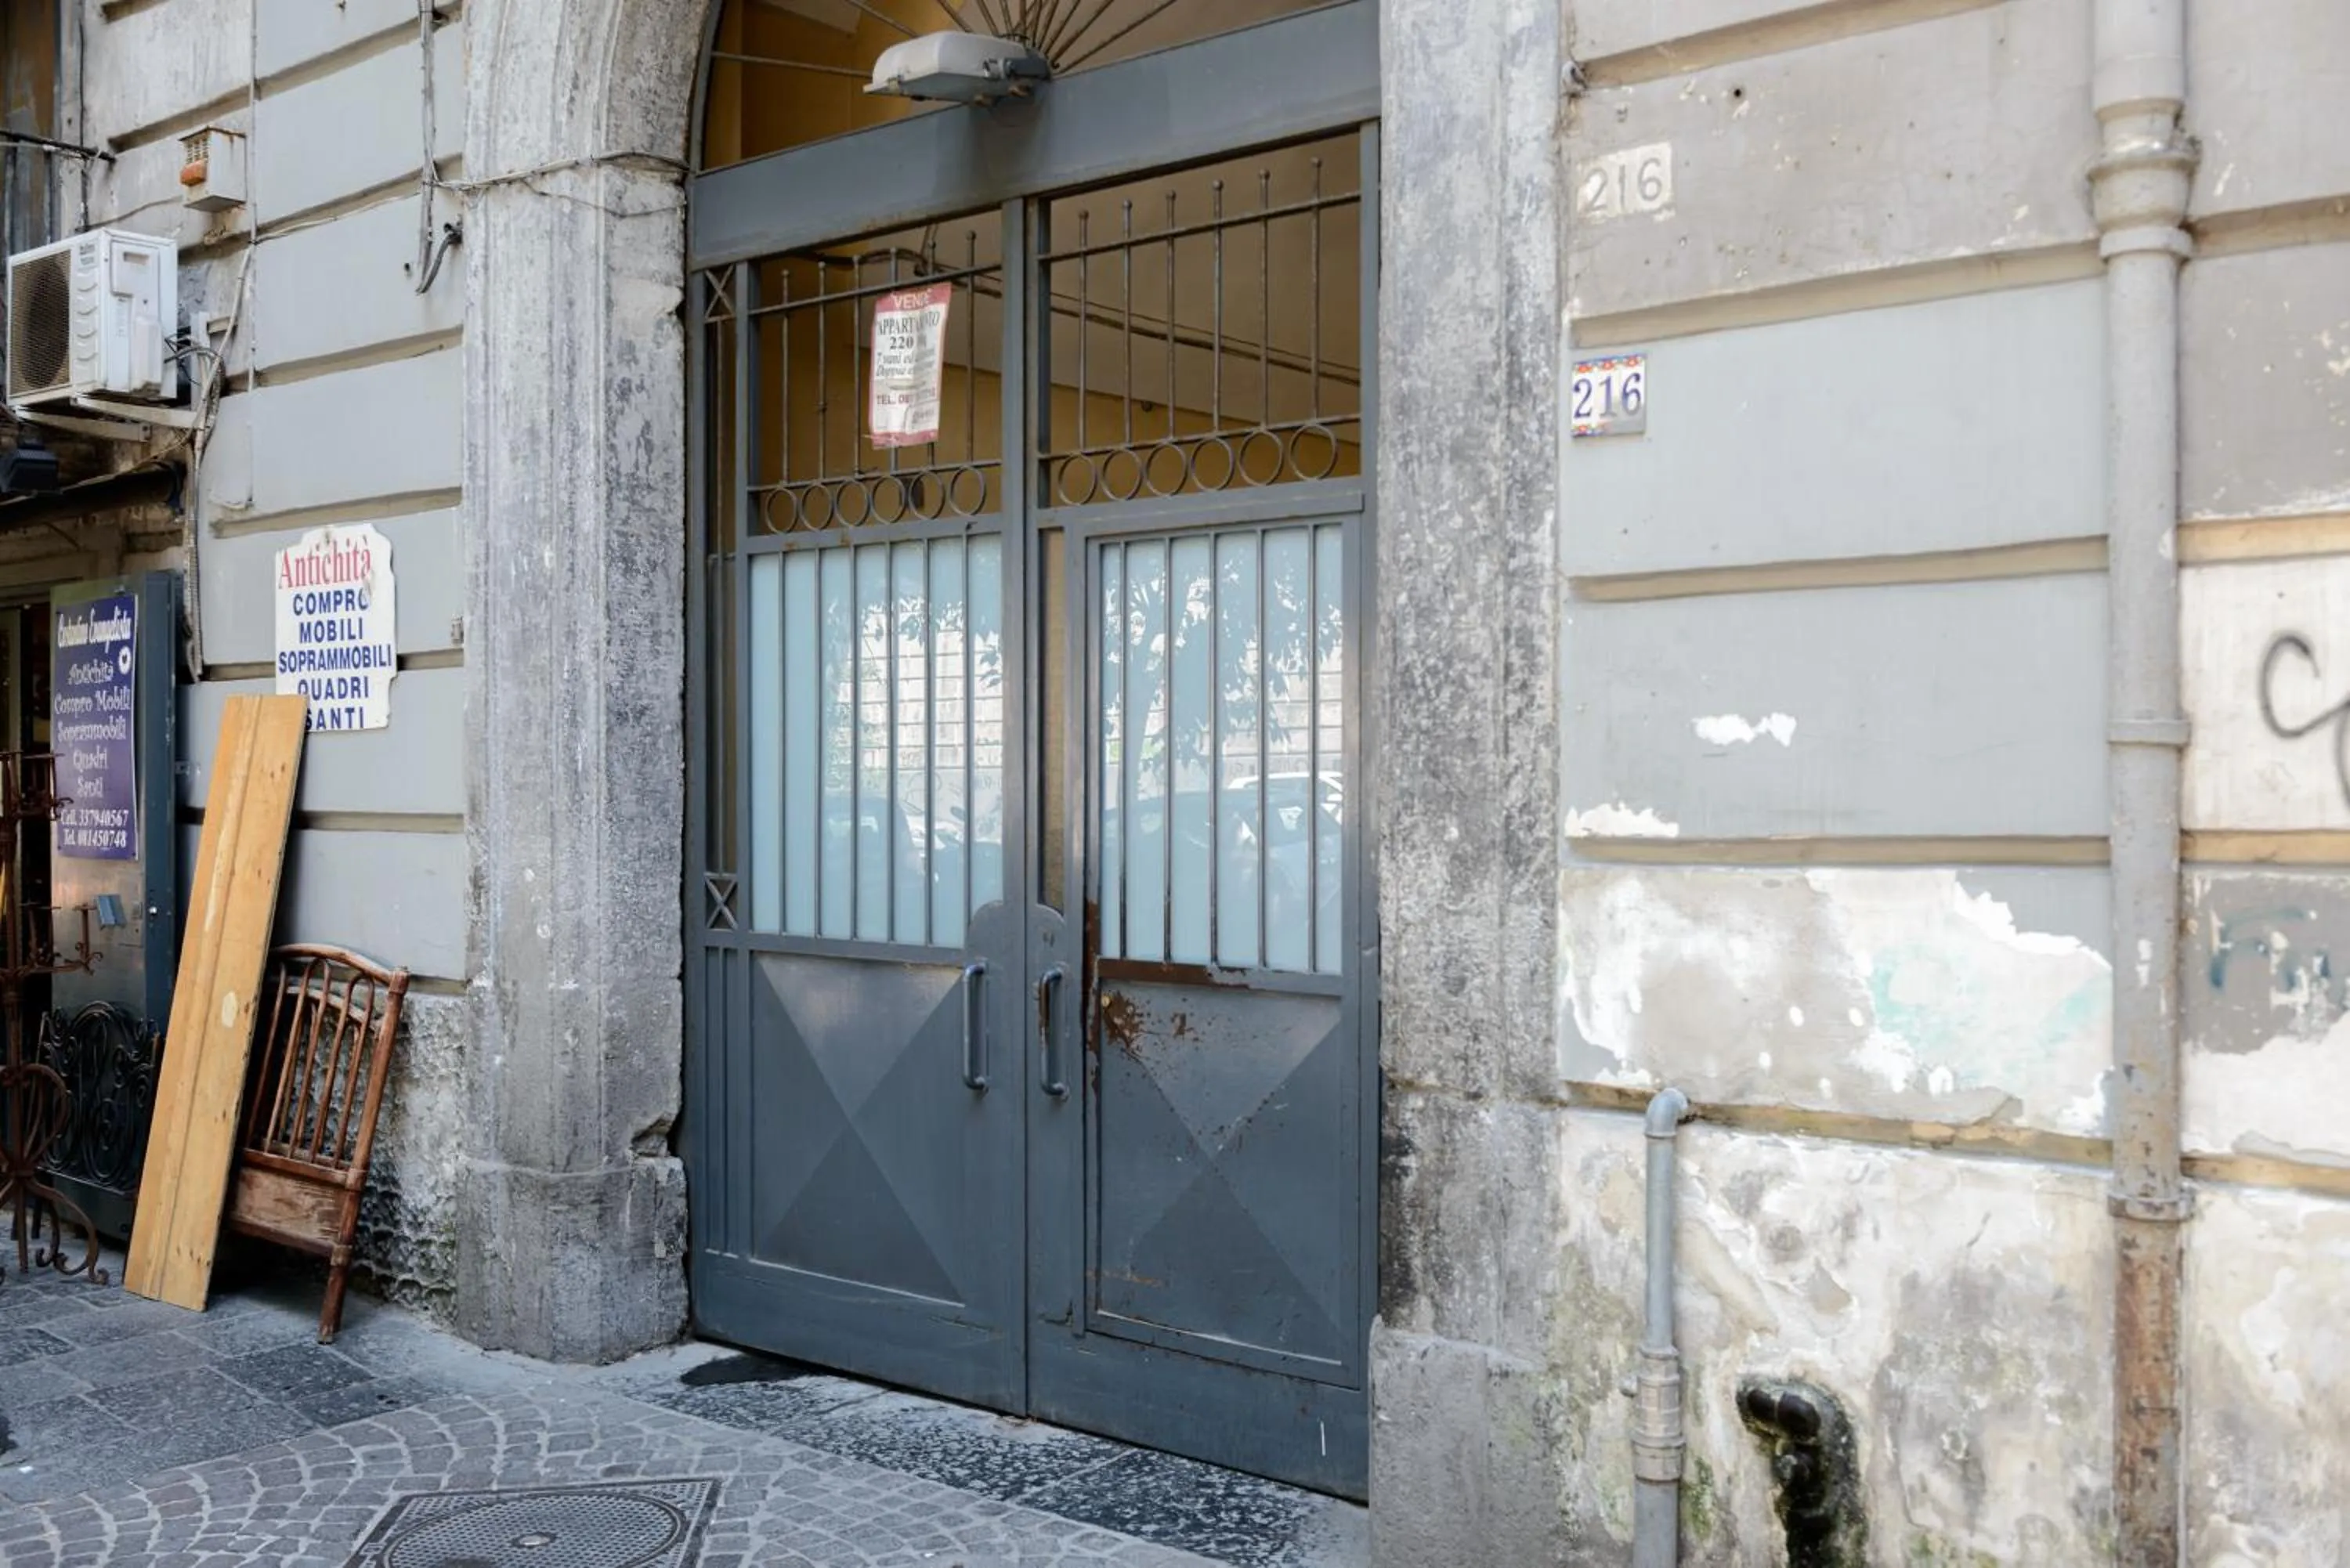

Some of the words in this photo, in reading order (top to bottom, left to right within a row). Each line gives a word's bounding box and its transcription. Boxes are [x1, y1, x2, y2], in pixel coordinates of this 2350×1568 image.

[1582, 157, 1662, 211] 216
[890, 336, 914, 349] 220
[1573, 372, 1642, 419] 216
[278, 534, 372, 589] Antichità
[293, 588, 369, 616] COMPRO
[299, 617, 363, 644] MOBILI
[278, 643, 392, 674] SOPRAMMOBILI
[298, 675, 369, 701] QUADRI
[54, 692, 93, 718] Compro
